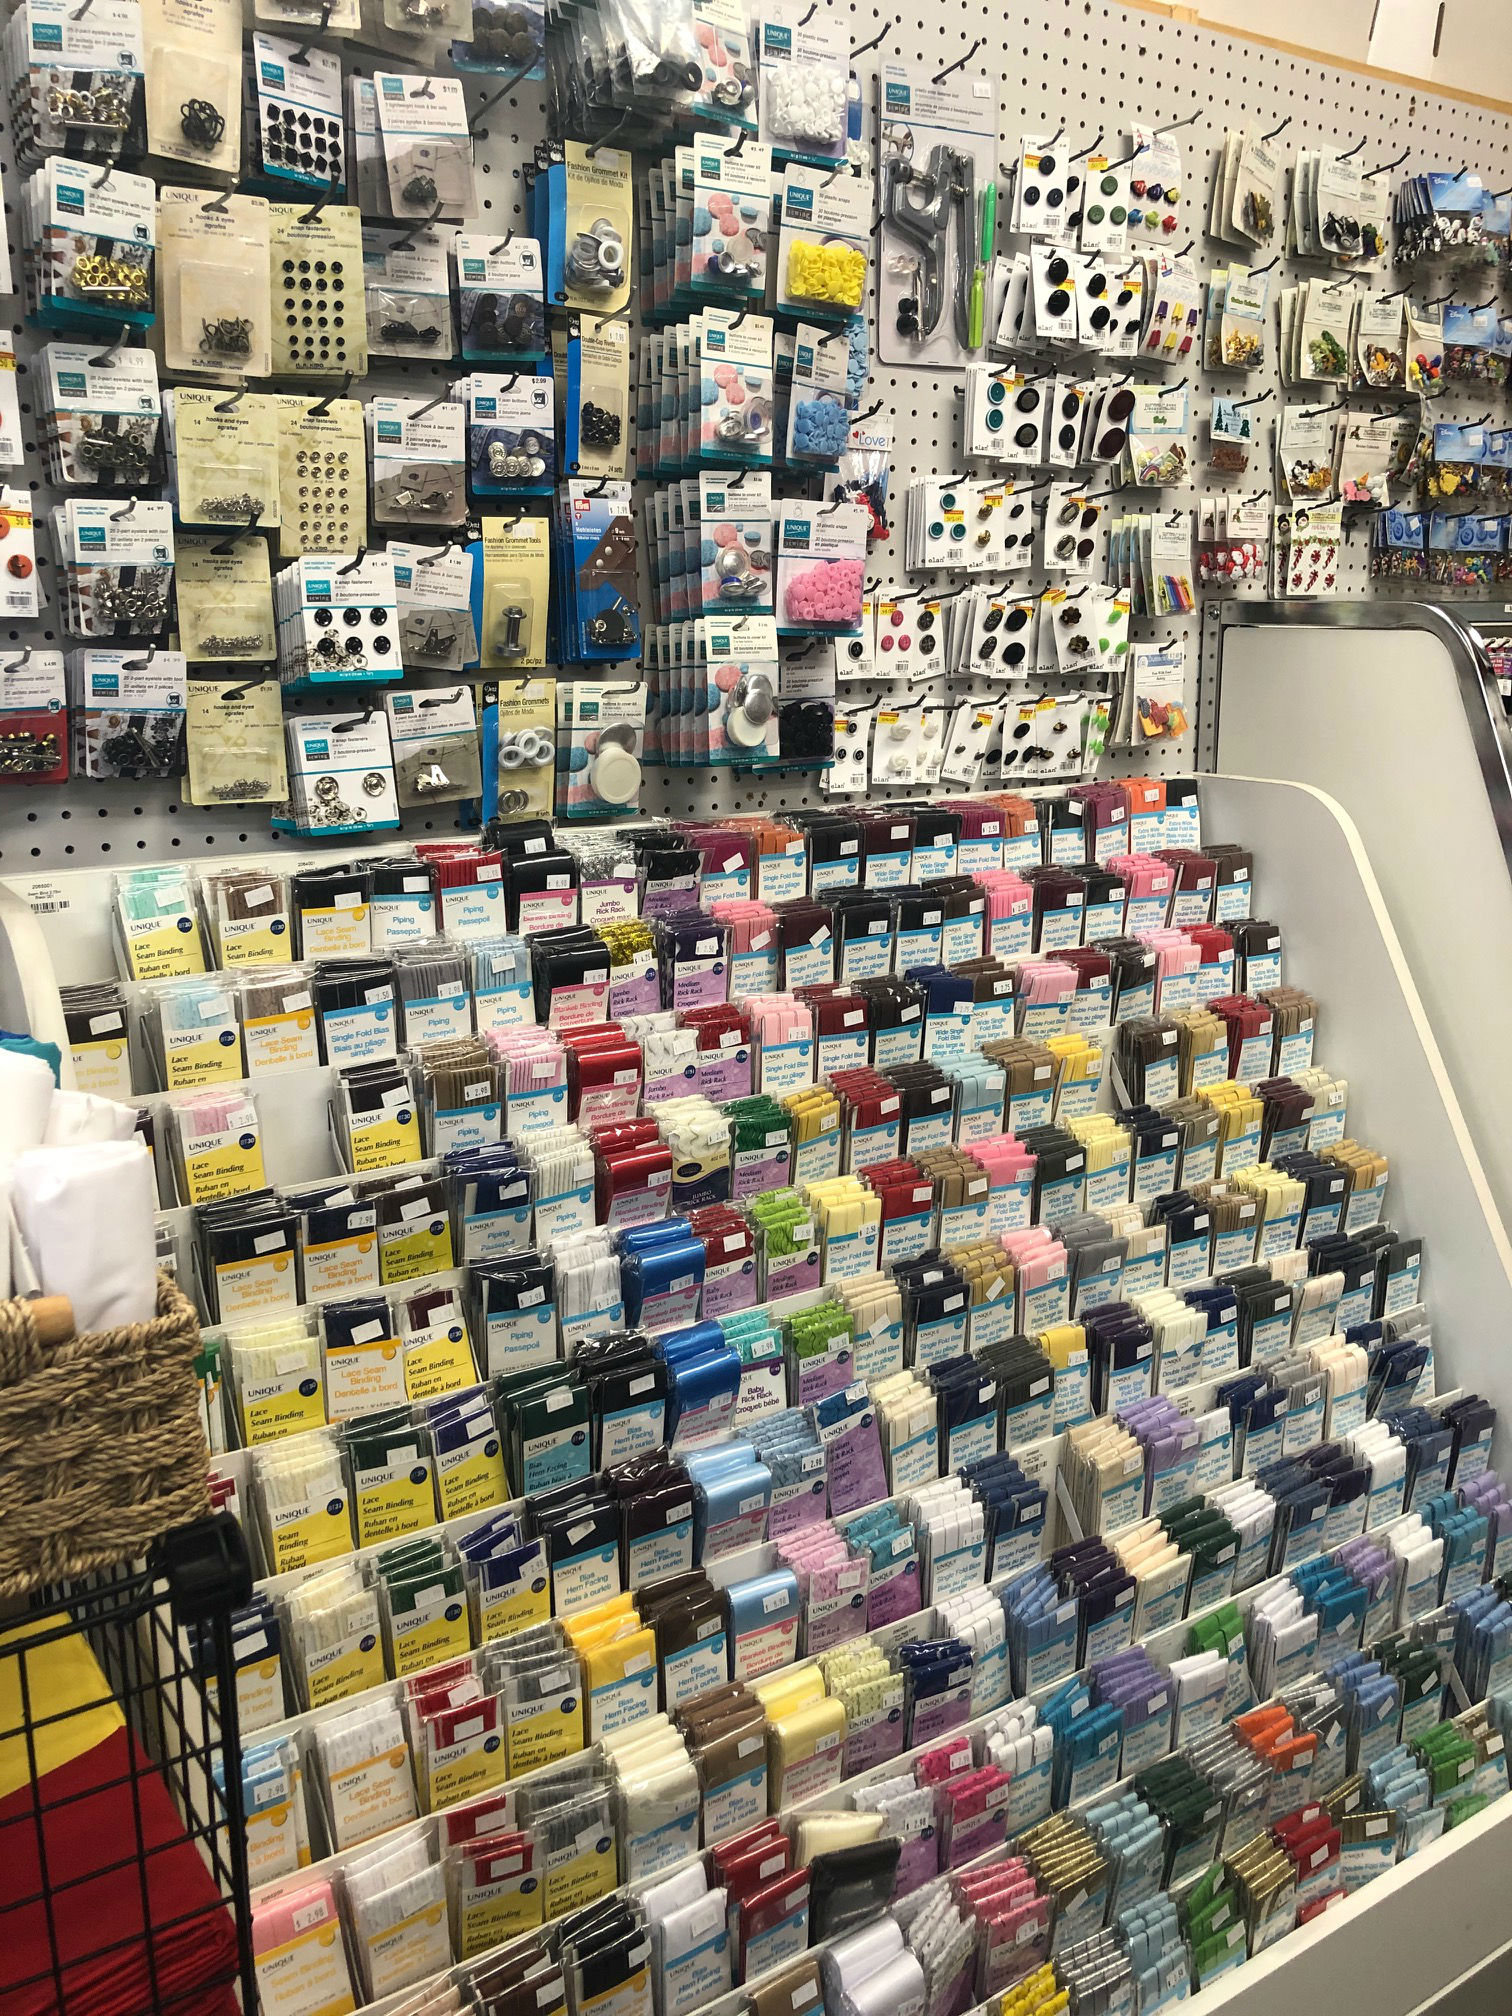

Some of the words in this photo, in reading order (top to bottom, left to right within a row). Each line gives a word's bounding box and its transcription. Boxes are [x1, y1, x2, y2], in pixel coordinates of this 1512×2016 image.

[766, 29, 790, 40] UNIQUE
[567, 162, 590, 173] Fashion
[591, 166, 618, 177] Grommet
[619, 170, 628, 179] Kit
[166, 192, 198, 202] UNIQUE
[789, 191, 812, 200] UNIQUE
[179, 393, 213, 402] UNIQUE
[277, 399, 304, 407] UNIQUE
[859, 430, 885, 446] Love
[785, 523, 808, 532] UNIQUE
[505, 537, 528, 545] Grommet
[527, 657, 542, 665] pc/pz
[500, 698, 520, 707] Fashion
[522, 697, 549, 706] Grommets
[762, 874, 779, 883] Single
[781, 872, 791, 881] Fold
[792, 871, 803, 879] Bias
[445, 895, 469, 904] UNIQUE
[599, 900, 620, 909] Jumbo
[373, 903, 400, 912] UNIQUE
[463, 904, 484, 915] Piping
[596, 906, 609, 915] Rick
[610, 905, 625, 914] Rack
[130, 920, 162, 932] UNIQUE
[307, 916, 334, 925] UNIQUE
[393, 916, 415, 925] Piping
[458, 915, 490, 927] Passepoil
[224, 922, 256, 932] UNIQUE
[387, 927, 421, 936] Passepoil
[134, 943, 150, 951] Lace
[226, 943, 242, 952] Lace
[135, 950, 155, 960] Seam
[157, 946, 184, 956] Binding
[226, 951, 246, 960] Seam
[247, 947, 274, 957] Binding
[139, 964, 160, 974] Ruban
[677, 963, 702, 973] UNIQUE
[677, 979, 700, 989] Medium
[428, 1016, 449, 1027] Piping
[169, 1033, 203, 1044] UNIQUE
[331, 1031, 354, 1044] Single
[355, 1028, 372, 1039] Fold
[373, 1026, 390, 1036] Bias
[422, 1027, 456, 1039] Passepoil
[334, 1043, 352, 1054] Biais
[364, 1037, 387, 1050] pliage
[350, 1047, 374, 1058] simple
[171, 1055, 188, 1063] Lace
[172, 1063, 192, 1073] Seam
[194, 1059, 222, 1070] Binding
[173, 1077, 195, 1087] Ruban
[457, 1126, 480, 1138] Piping
[189, 1137, 223, 1150] UNIQUE
[451, 1137, 485, 1148] Passepoil
[740, 1154, 763, 1162] UNIQUE
[192, 1161, 209, 1170] Lace
[193, 1169, 214, 1180] Seam
[216, 1163, 244, 1175] Binding
[195, 1183, 218, 1194] Ruban
[382, 1226, 415, 1239] UNIQUE
[309, 1252, 338, 1262] UNIQUE
[491, 1321, 518, 1330] UNIQUE
[403, 1332, 434, 1347] UNIQUE
[511, 1330, 533, 1341] Piping
[504, 1341, 540, 1353] Passepoil
[331, 1356, 360, 1366] UNIQUE
[406, 1356, 422, 1366] Lace
[408, 1364, 426, 1376] Seam
[428, 1356, 455, 1370] Binding
[411, 1378, 430, 1390] Ruban
[412, 1385, 438, 1400] dentelle
[446, 1378, 461, 1389] bord
[248, 1384, 284, 1398] UNIQUE
[747, 1386, 765, 1396] Baby
[741, 1393, 755, 1404] Rick
[756, 1390, 773, 1400] Rack
[735, 1403, 762, 1415] Croquet
[764, 1397, 780, 1407] bébé
[361, 1472, 395, 1485] UNIQUE
[362, 1495, 380, 1505] Lace
[363, 1503, 383, 1514] Seam
[385, 1497, 414, 1512] Binding
[275, 1506, 311, 1522] UNIQUE
[364, 1518, 386, 1528] Ruban
[365, 1525, 392, 1539] dentelle
[402, 1519, 418, 1529] bord
[277, 1530, 299, 1542] Seam
[279, 1538, 308, 1552] Binding
[579, 1570, 595, 1582] Bias
[566, 1582, 580, 1595] Hem
[582, 1574, 609, 1589] Facing
[485, 1587, 517, 1602] UNIQUE
[812, 1601, 839, 1614] UNIQUE
[511, 1704, 545, 1718] UNIQUE
[511, 1726, 529, 1737] Lace
[512, 1734, 533, 1746] Seam
[535, 1727, 563, 1741] Binding
[434, 1745, 468, 1763] UNIQUE
